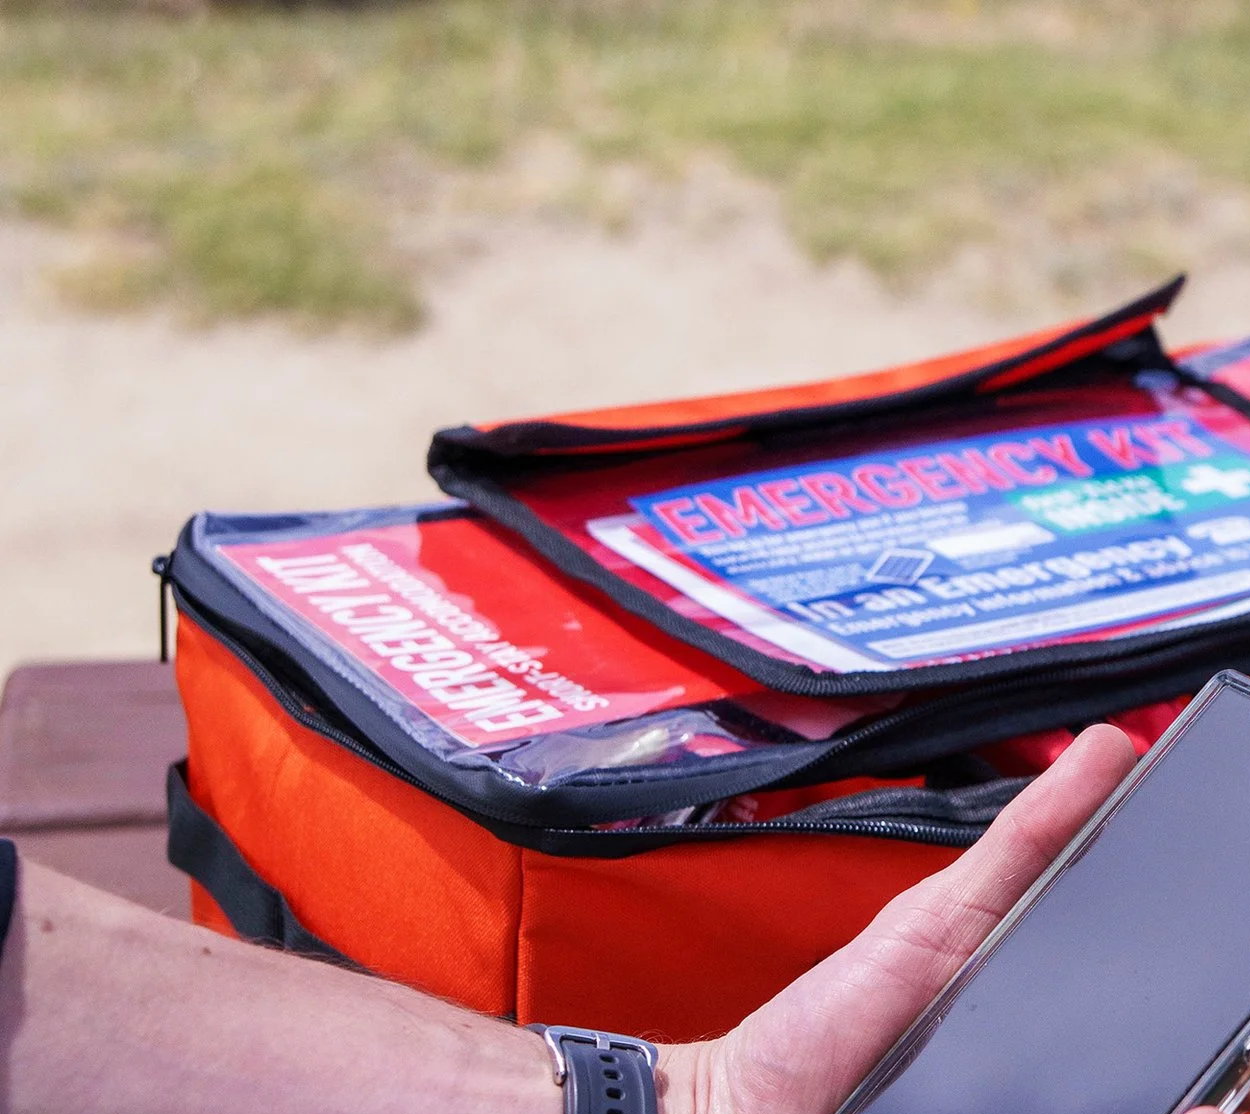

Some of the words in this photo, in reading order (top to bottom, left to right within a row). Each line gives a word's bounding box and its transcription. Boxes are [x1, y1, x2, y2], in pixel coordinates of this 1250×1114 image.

[652, 434, 1093, 547] EMERGENCY
[1087, 420, 1214, 471] KIT
[257, 553, 371, 594] KIT
[786, 600, 856, 623] In
[854, 587, 929, 612] an
[916, 535, 1193, 599] Emergency
[307, 593, 566, 732] EMERGENCY
